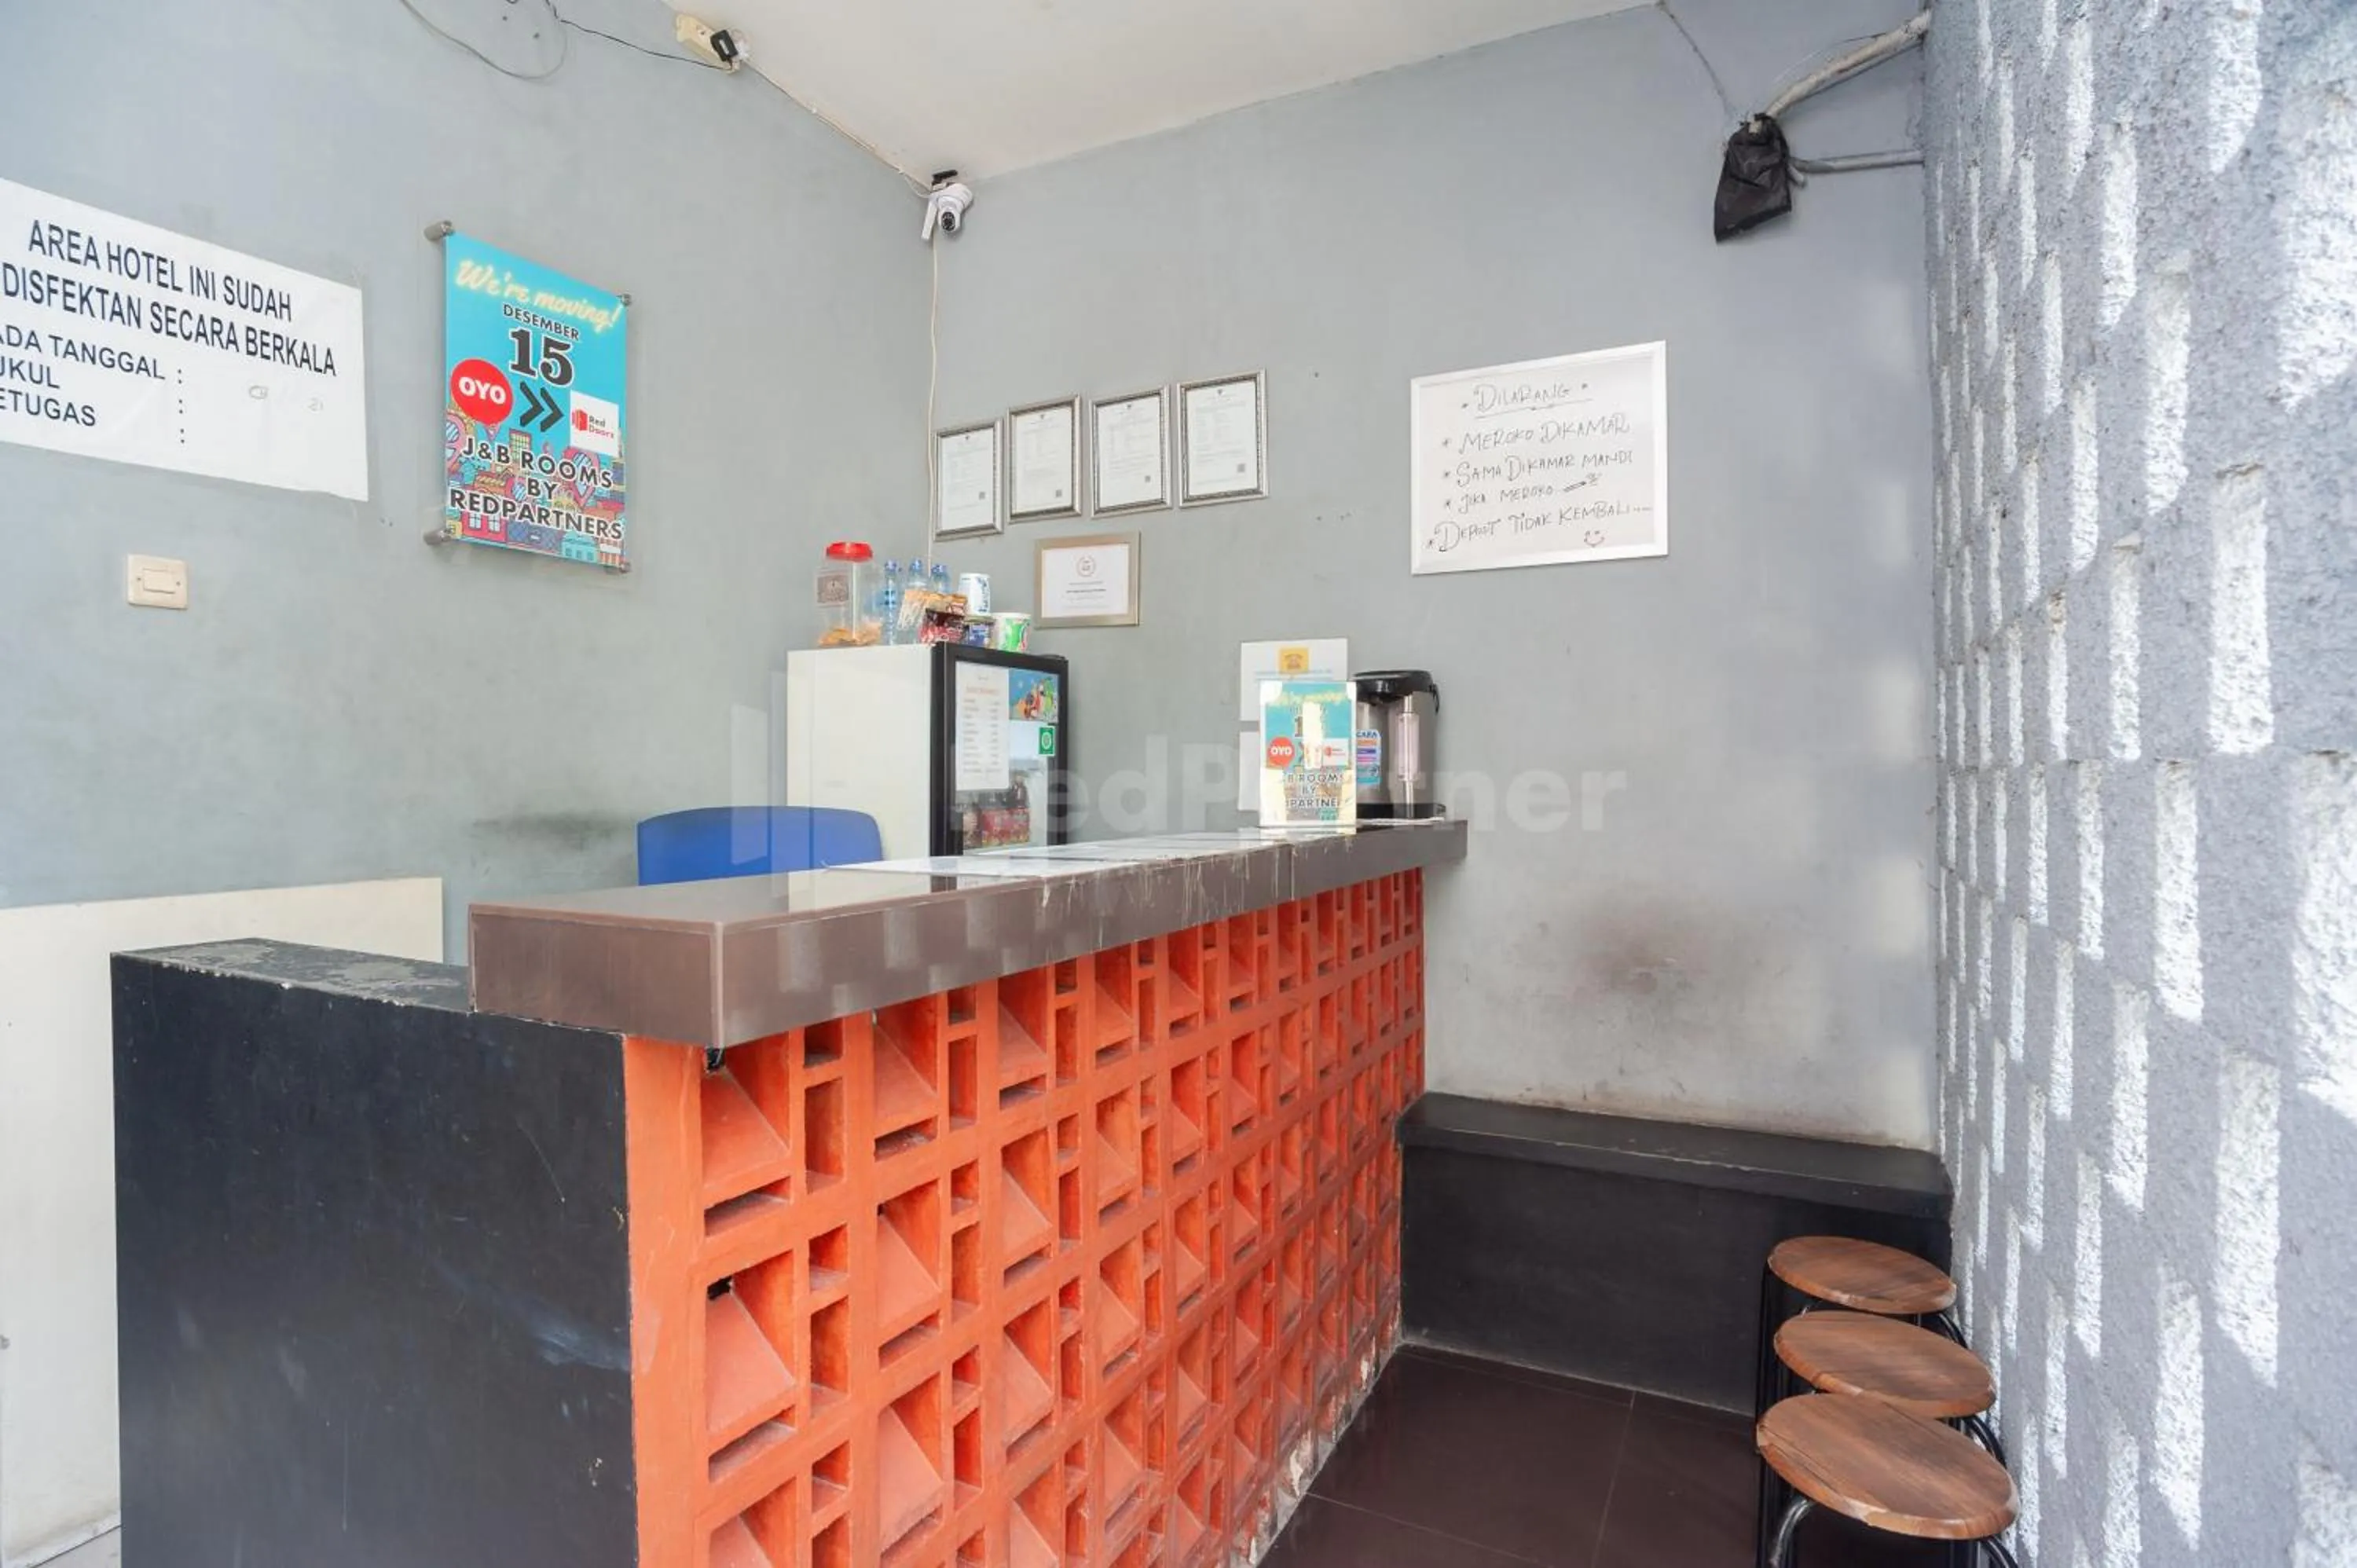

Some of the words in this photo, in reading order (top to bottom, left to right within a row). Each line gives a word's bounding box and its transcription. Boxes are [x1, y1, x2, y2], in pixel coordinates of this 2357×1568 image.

[28, 219, 101, 269] AREA
[106, 240, 183, 293] HOTEL
[189, 266, 216, 302] INI
[223, 275, 292, 323] SUDAH
[455, 259, 531, 303] We're
[533, 289, 624, 334] moving!
[2, 262, 143, 330] DISFEKTAN
[150, 301, 240, 353] SECARA
[246, 326, 337, 377] BERKALA
[503, 303, 580, 342] DESEMBER
[48, 334, 166, 380] TANGGAL
[509, 327, 575, 388] 15
[459, 378, 507, 406] OYO
[462, 438, 511, 464] J&B
[521, 453, 613, 489] ROOMS
[527, 476, 559, 498] BY
[449, 488, 623, 540] REDPARTNERS
[1270, 746, 1292, 756] OYO
